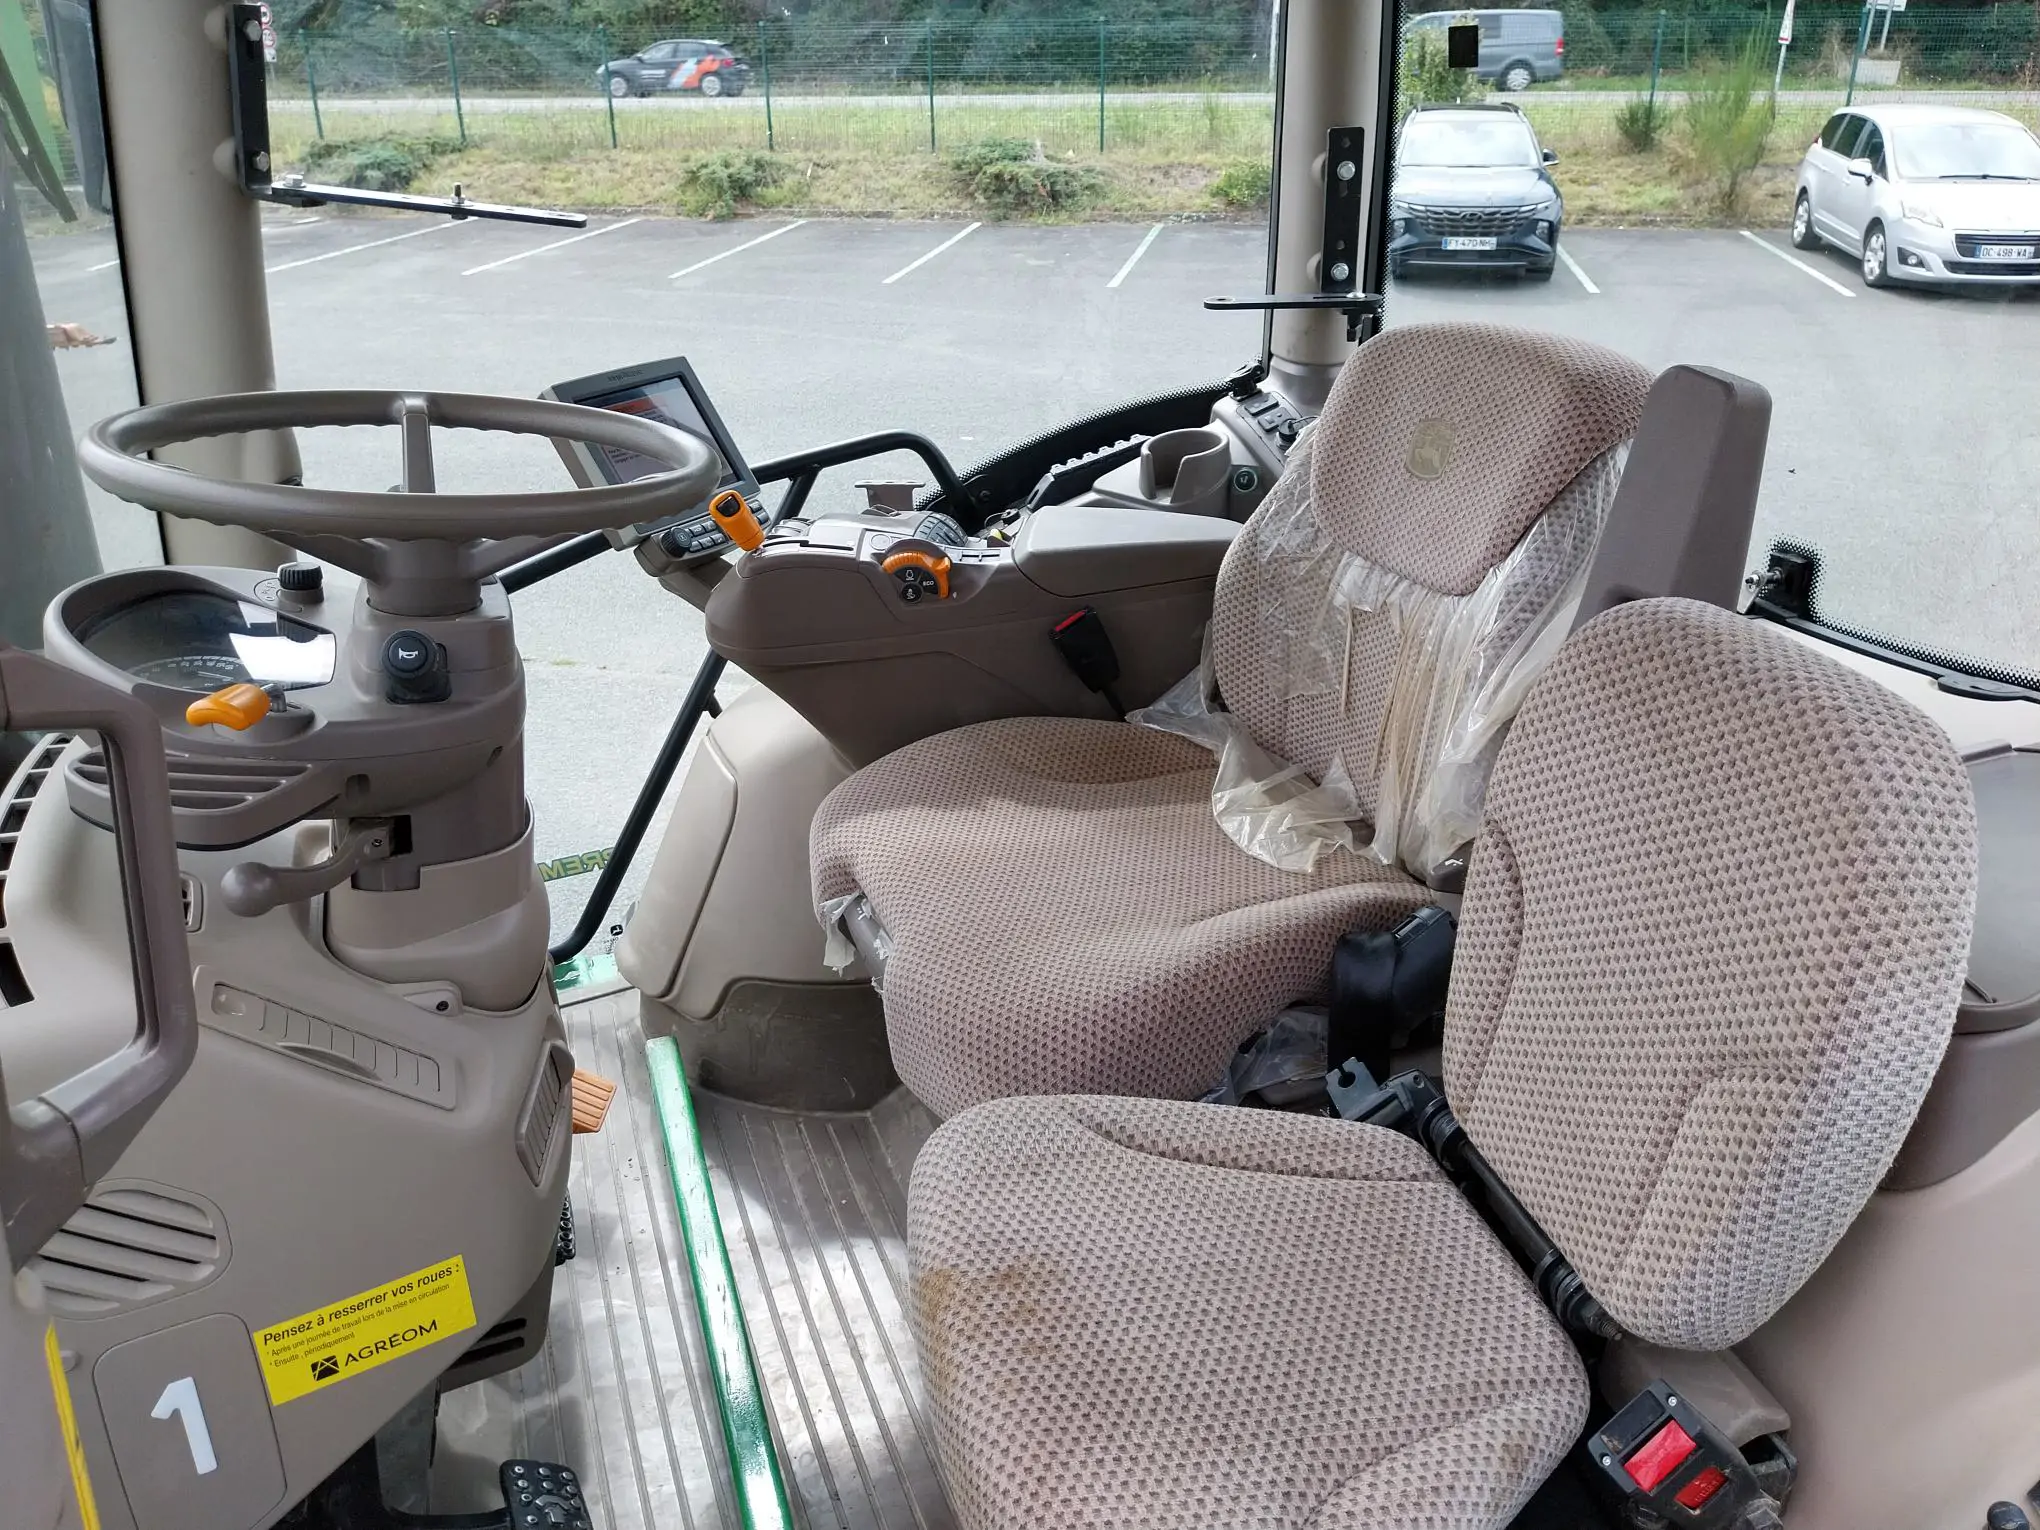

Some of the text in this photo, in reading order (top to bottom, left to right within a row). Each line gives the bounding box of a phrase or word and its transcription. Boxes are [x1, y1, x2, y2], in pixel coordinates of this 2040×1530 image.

[263, 1320, 313, 1346] Pensez
[317, 1314, 325, 1326] à
[328, 1291, 388, 1322] resserrer
[391, 1282, 414, 1297] vos
[417, 1266, 453, 1288] roues
[271, 1283, 450, 1357] Après une journée de travail lors de la mise en circulation
[345, 1319, 438, 1367] AGRÉOM
[274, 1352, 299, 1368] Ensuite
[304, 1332, 355, 1358] périodiquement
[150, 1376, 218, 1475] 1
